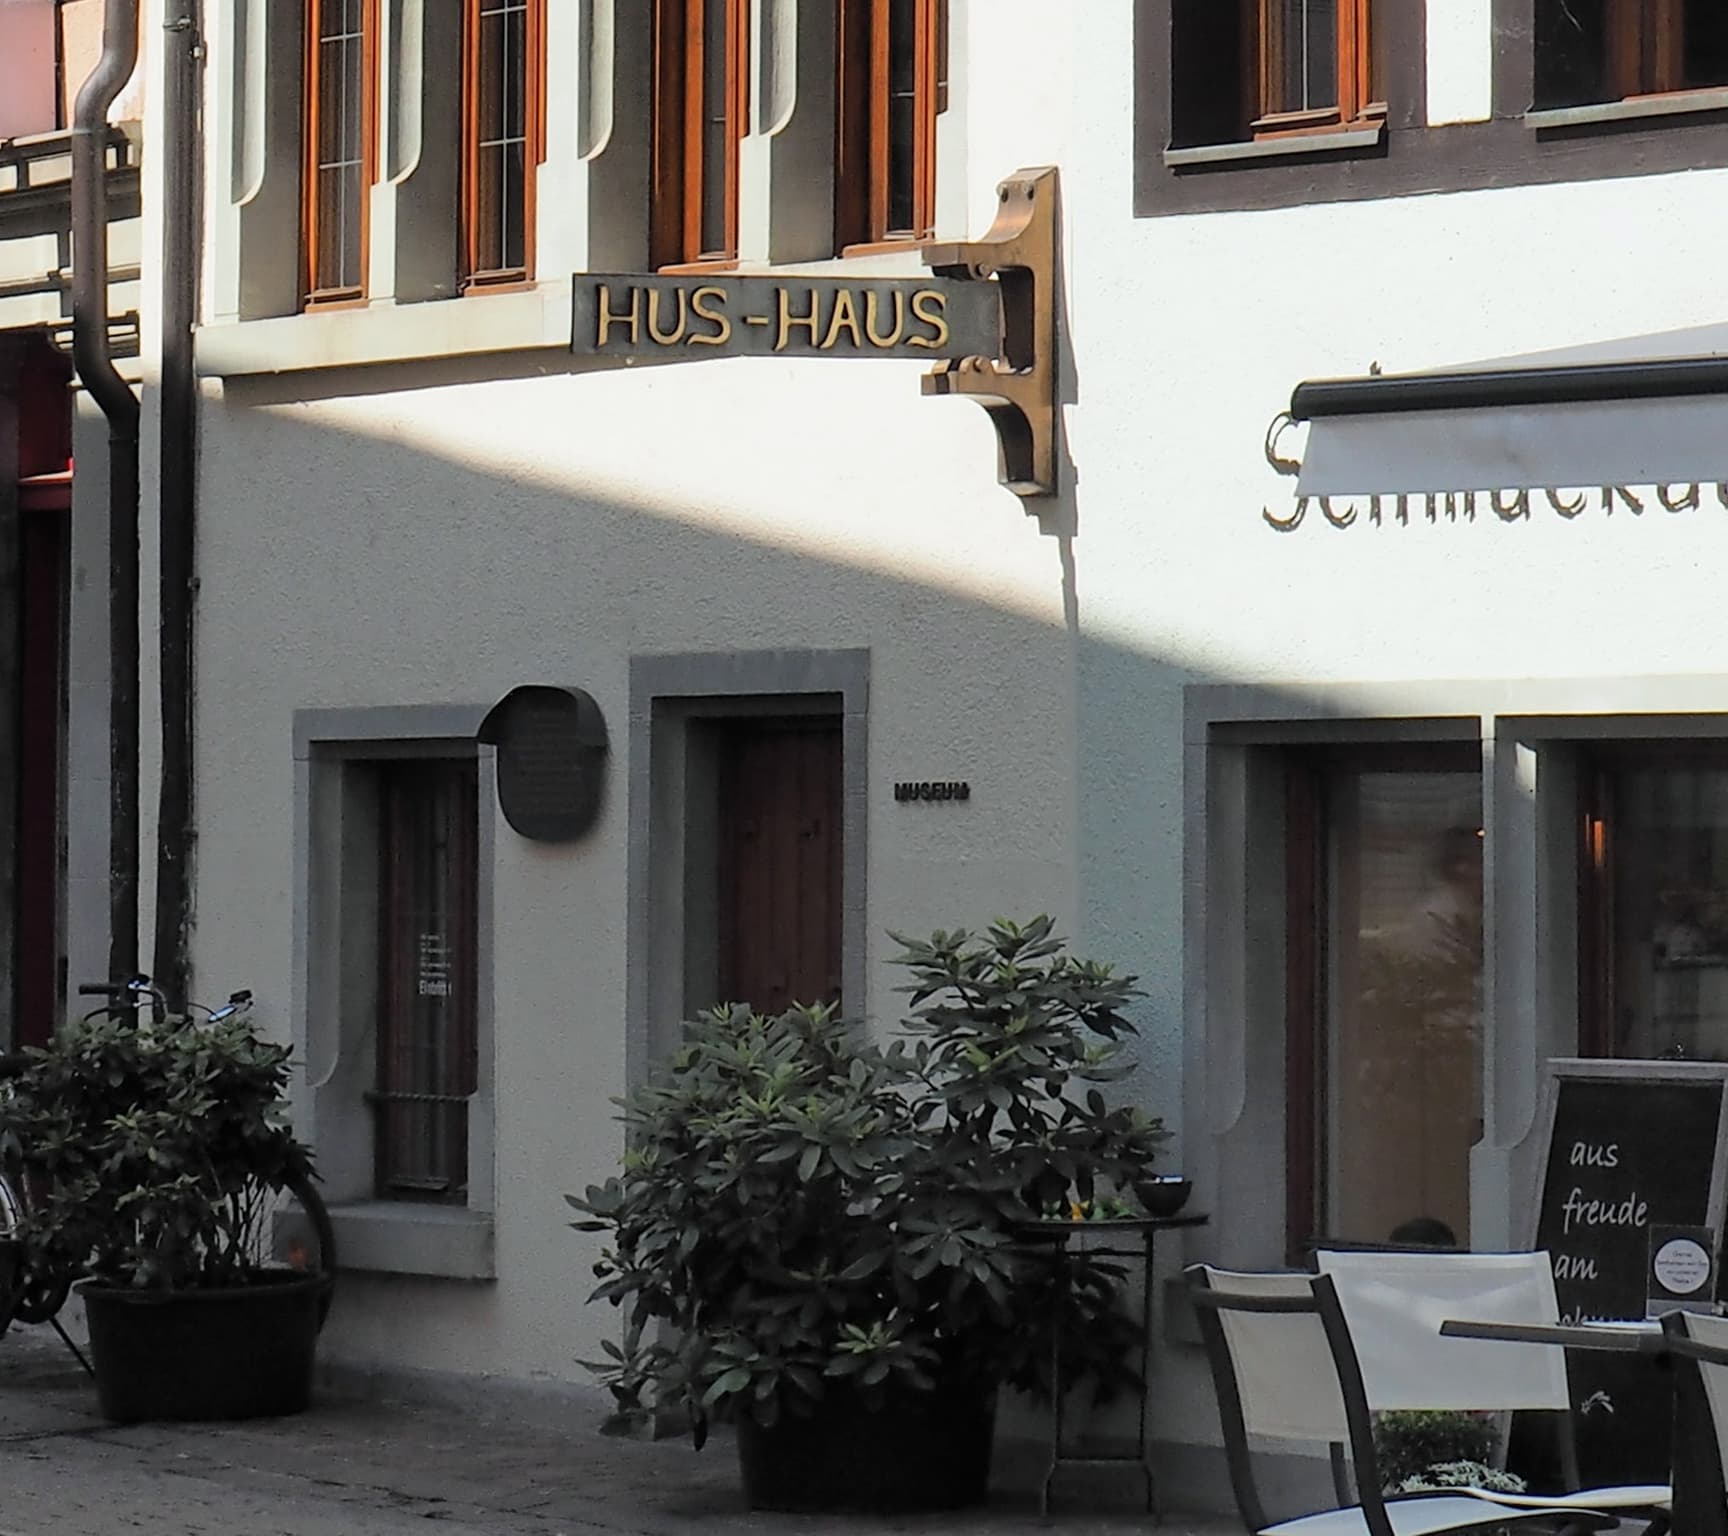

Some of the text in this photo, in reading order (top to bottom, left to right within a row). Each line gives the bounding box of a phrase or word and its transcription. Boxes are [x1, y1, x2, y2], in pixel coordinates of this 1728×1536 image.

[894, 781, 970, 802] MUSEUM
[1570, 1141, 1620, 1168] aus
[1561, 1186, 1648, 1235] freude
[1554, 1253, 1598, 1280] am
